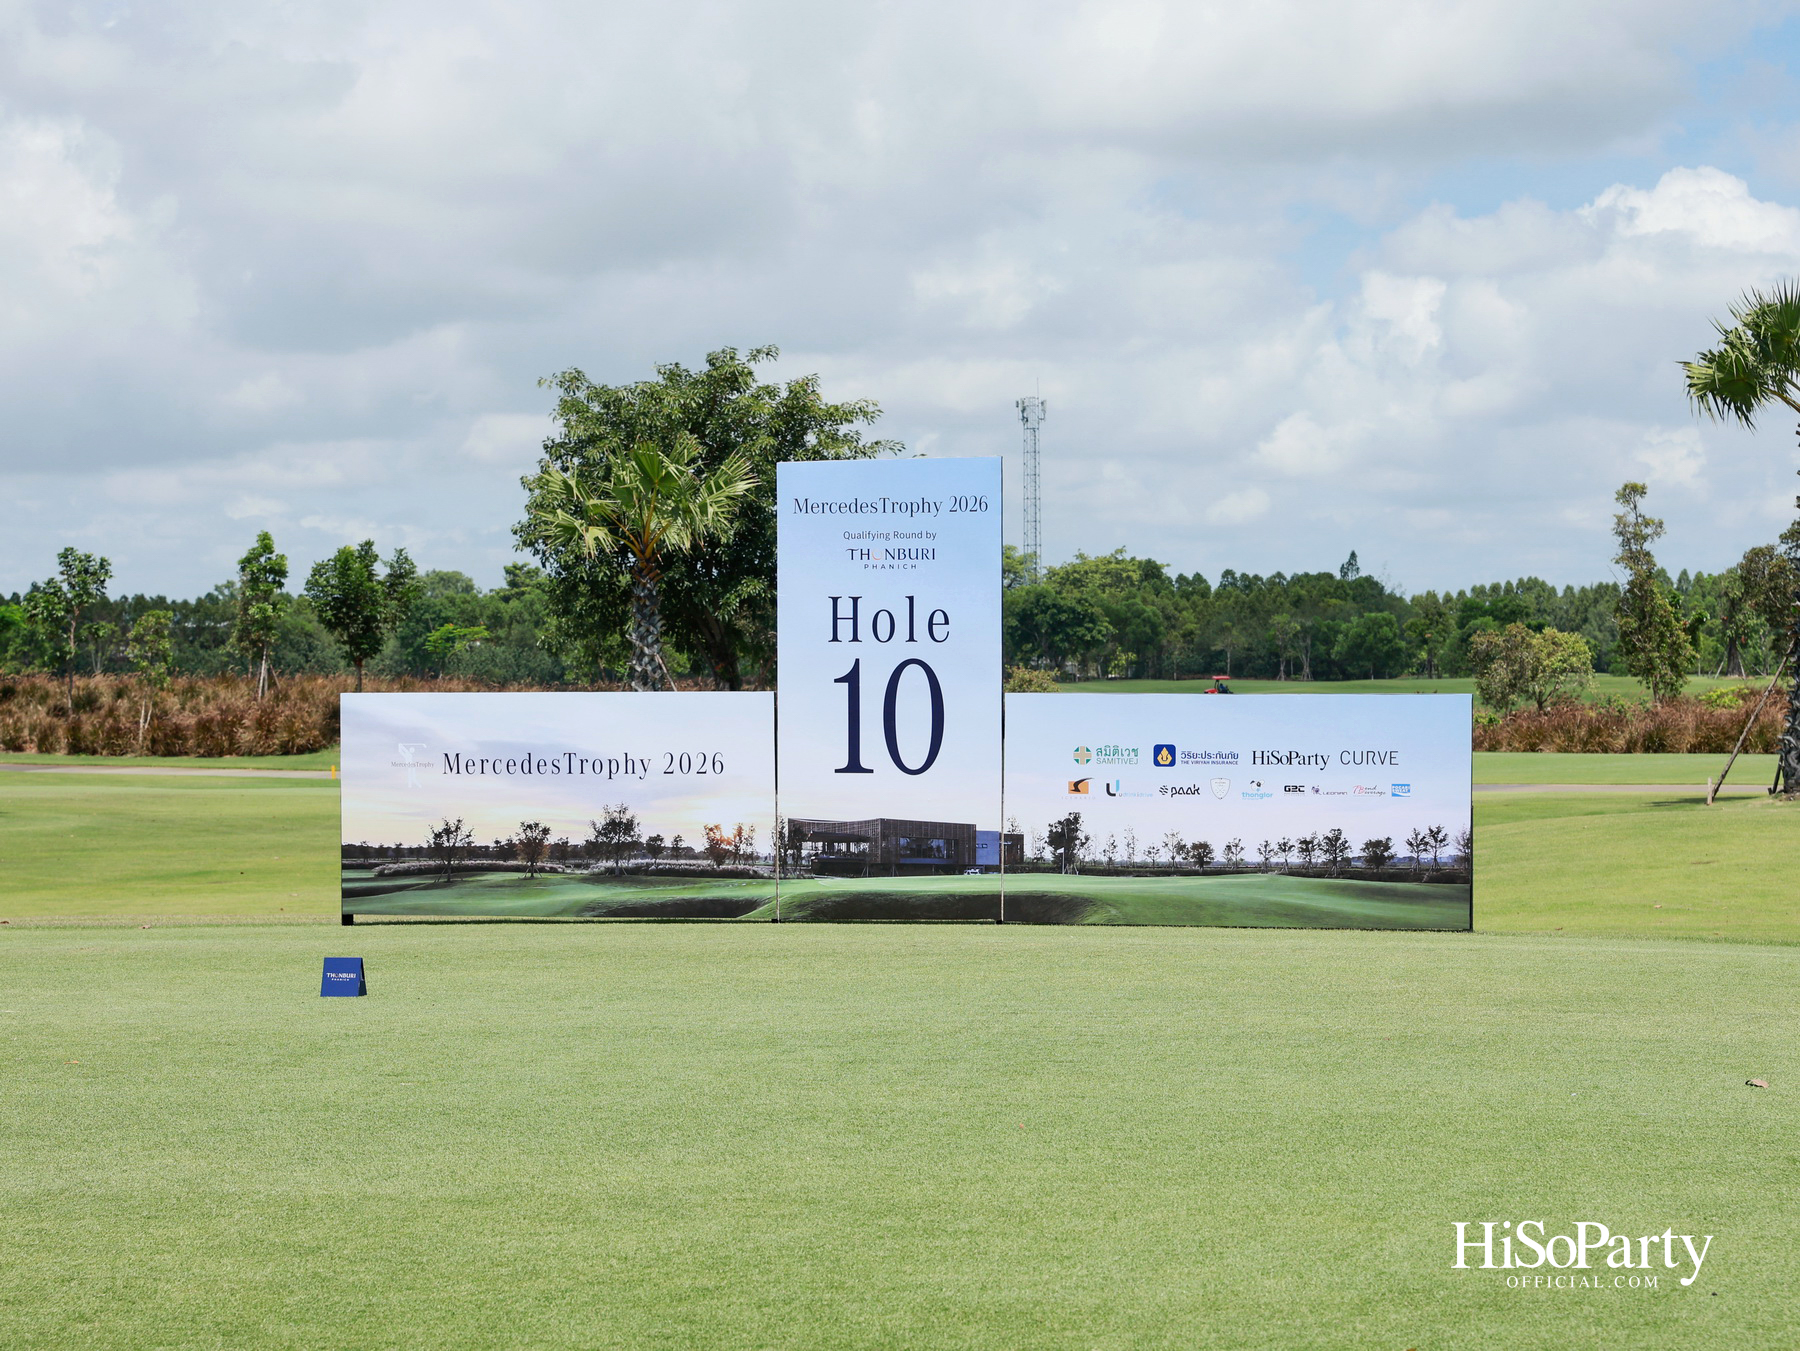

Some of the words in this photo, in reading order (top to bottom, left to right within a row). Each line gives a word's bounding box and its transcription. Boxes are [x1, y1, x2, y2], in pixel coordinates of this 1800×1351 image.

[793, 497, 943, 518] MercedesTrophy
[948, 494, 989, 514] 2026
[843, 531, 890, 541] Qualifying
[893, 530, 923, 540] Round
[925, 530, 937, 541] by
[846, 547, 936, 561] THONBURI
[828, 595, 950, 643] Hole
[834, 658, 945, 776] 10
[1095, 745, 1139, 757] สมิติเวช
[1180, 750, 1239, 760] วิริยะประกันภัย
[1340, 750, 1399, 766] CURVE
[442, 752, 652, 780] MercedesTrophy
[663, 752, 725, 775] 2026
[1096, 757, 1139, 765] SAMITIVEJ
[1252, 749, 1330, 771] HiSoParty
